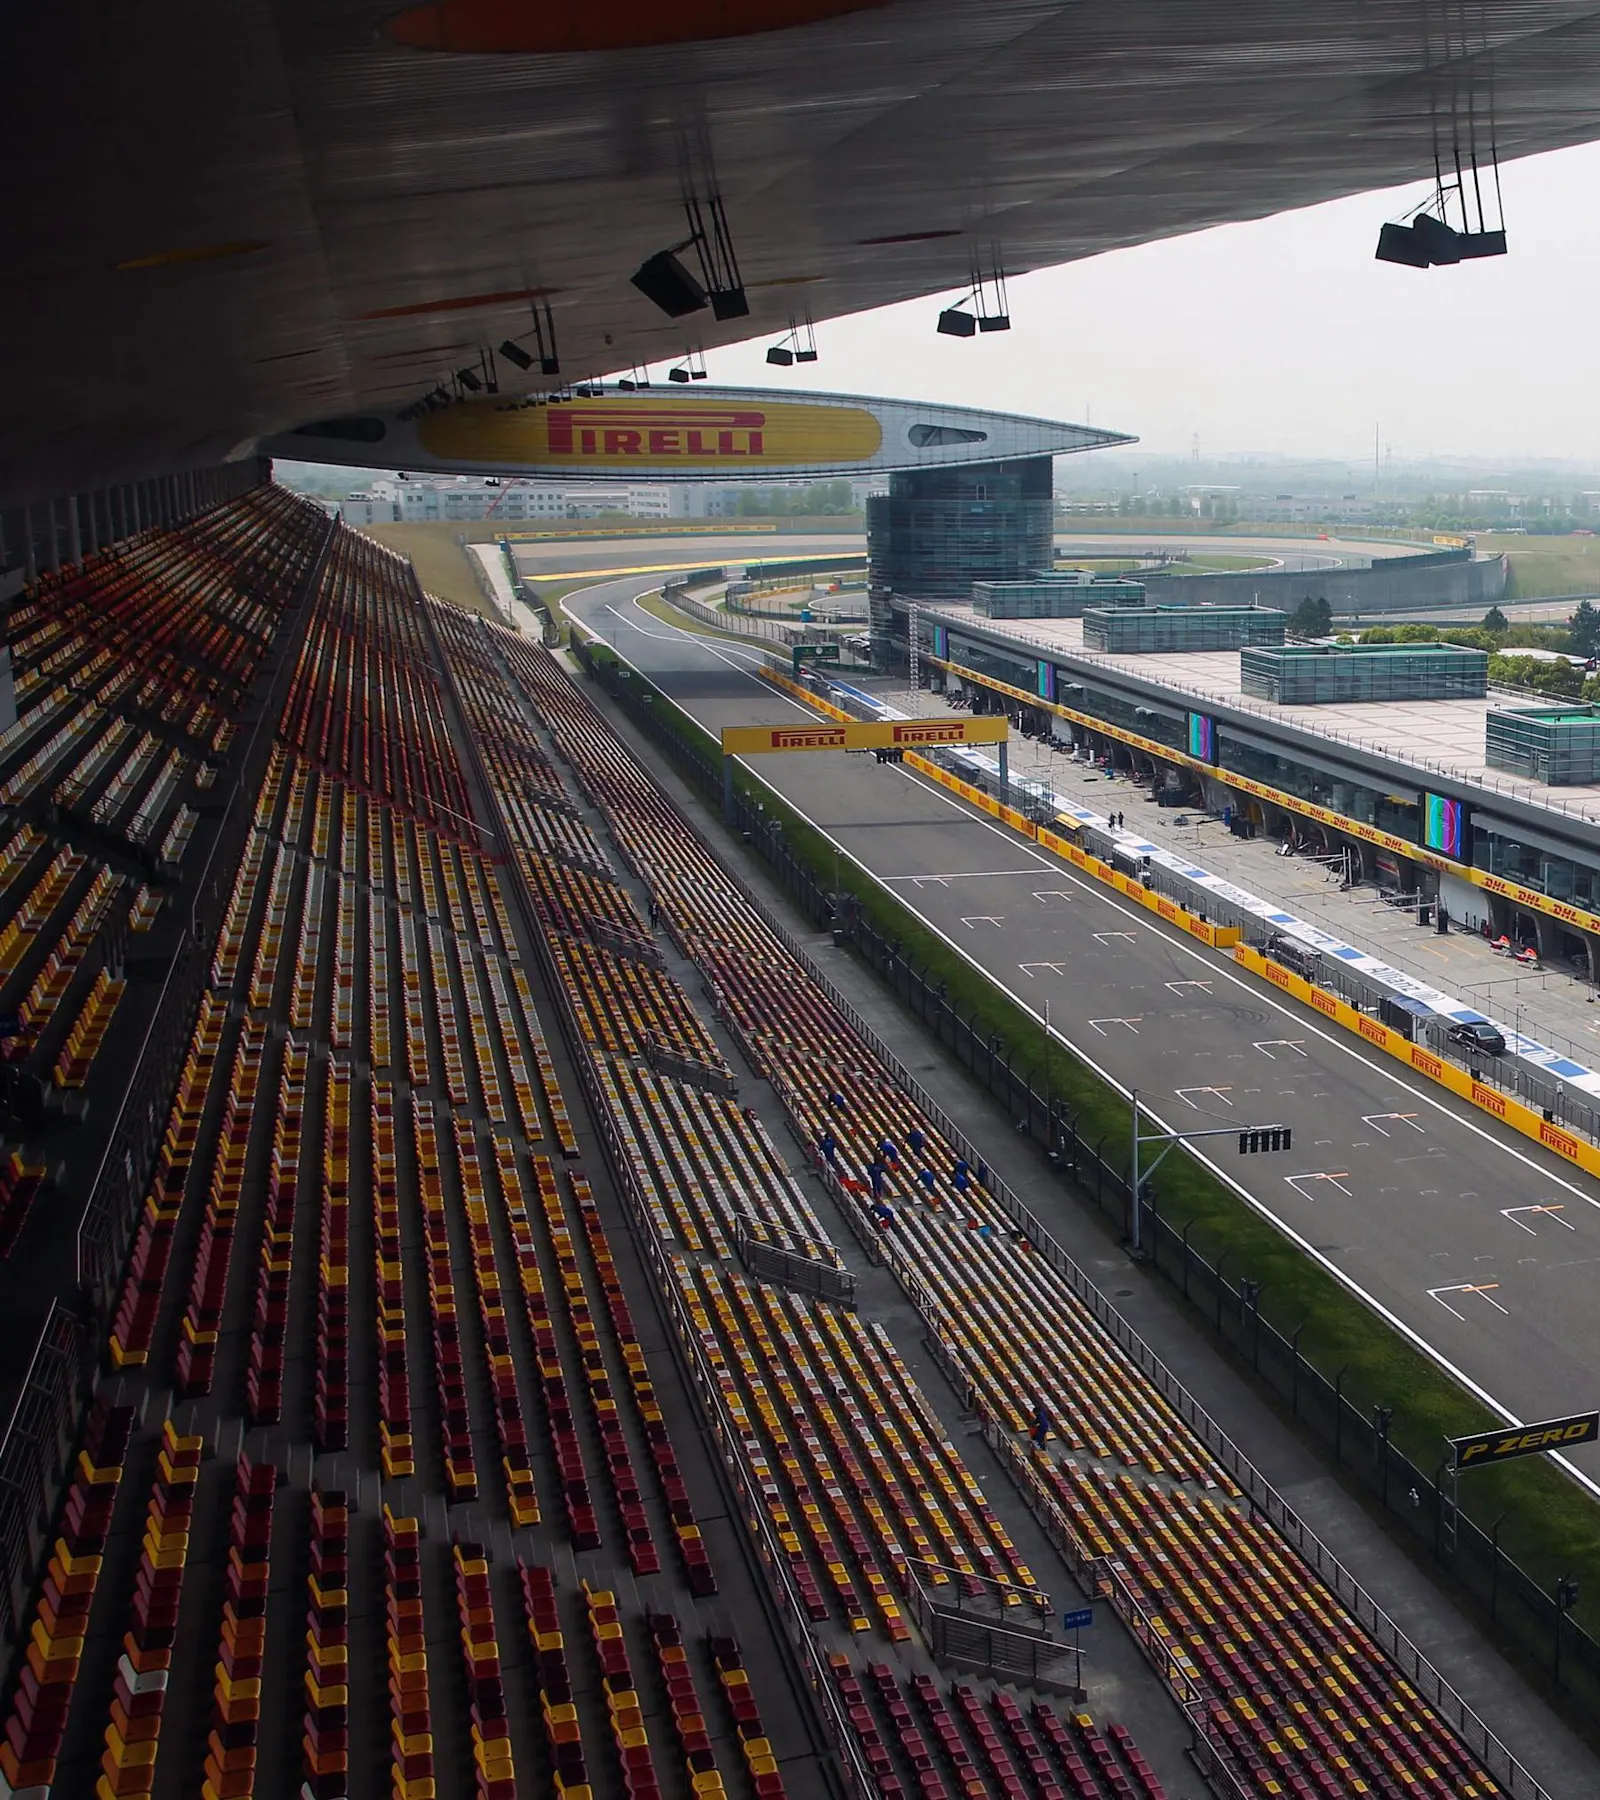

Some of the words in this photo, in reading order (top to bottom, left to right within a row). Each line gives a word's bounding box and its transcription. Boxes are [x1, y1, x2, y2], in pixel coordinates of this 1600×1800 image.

[547, 409, 766, 456] PIRELLI
[771, 728, 846, 748] PIRELLI
[893, 723, 965, 742] PIRELLI
[1358, 826, 1377, 842] DHL
[1384, 837, 1403, 852] DHL
[1484, 877, 1507, 893] DHL
[1517, 891, 1542, 908] DHL
[1552, 904, 1577, 922] DHL
[1265, 963, 1289, 988] PIRELLI
[1311, 990, 1336, 1017] PIRELLI
[1359, 1018, 1387, 1046] PIRELLI
[1411, 1048, 1442, 1079] PIRELLI
[1472, 1083, 1506, 1117] PIRELLI
[1540, 1122, 1578, 1159] PIRELLI
[1462, 1443, 1489, 1461] P
[1494, 1422, 1591, 1454] ZERO
